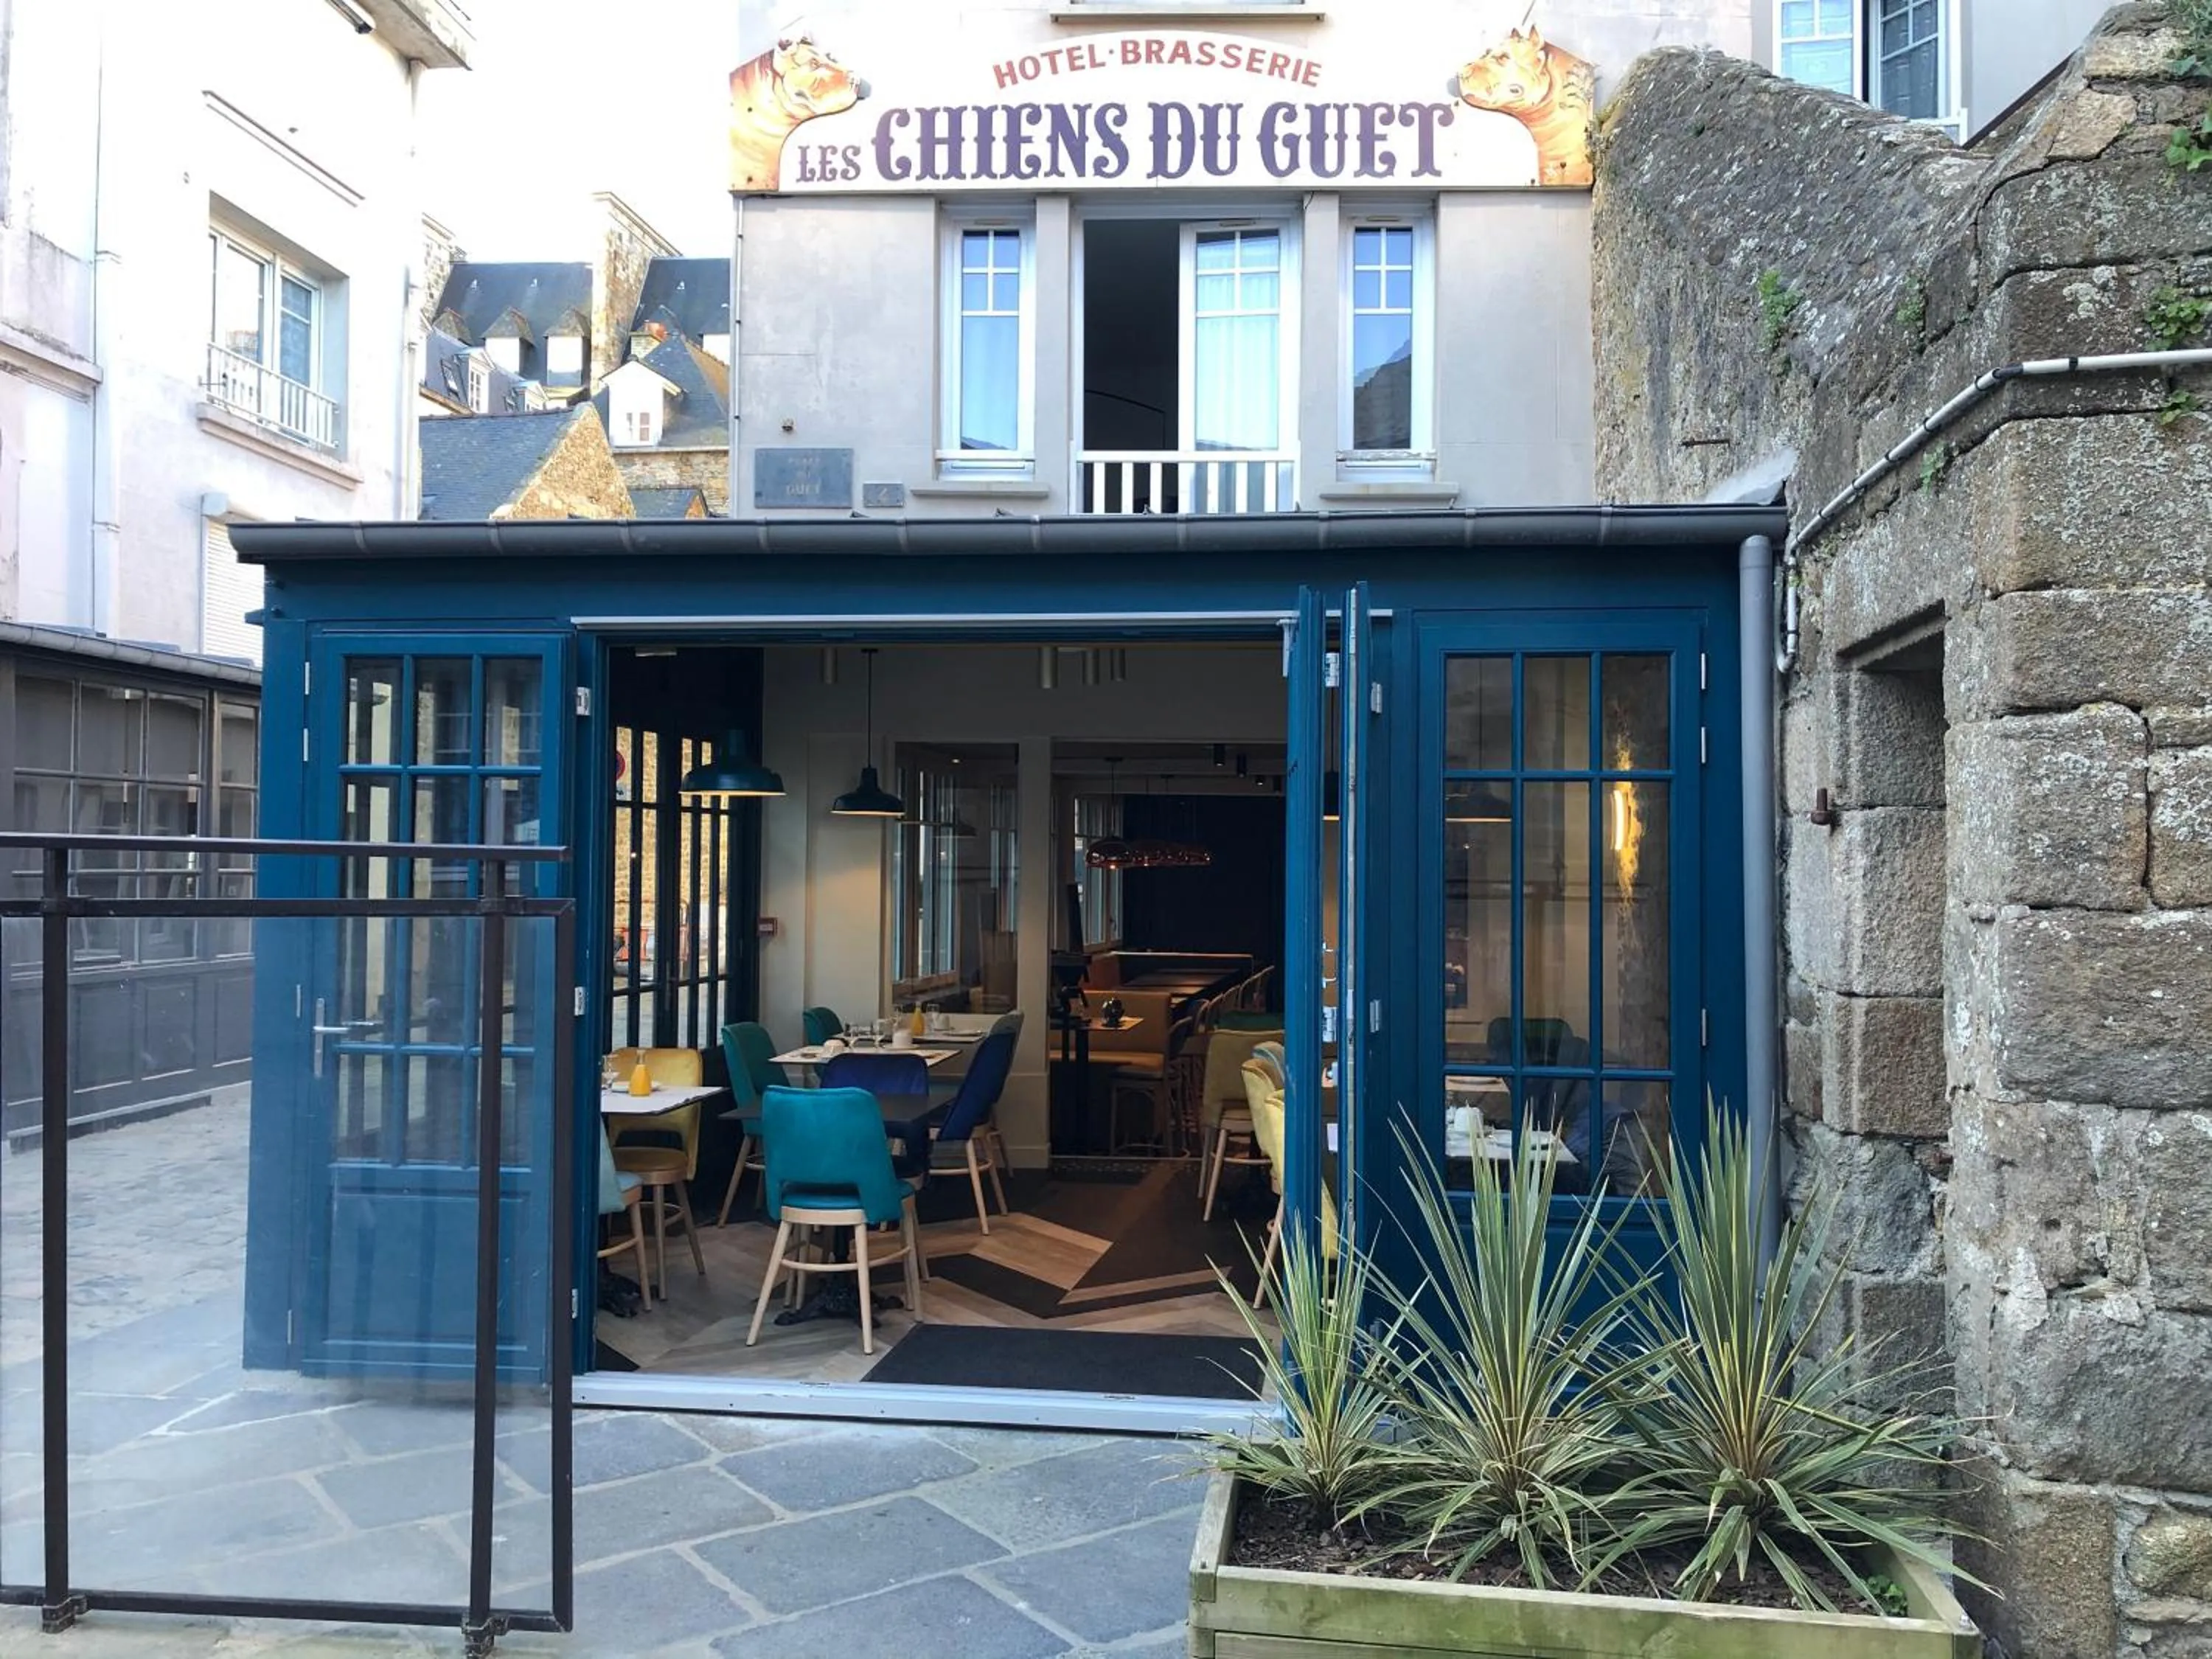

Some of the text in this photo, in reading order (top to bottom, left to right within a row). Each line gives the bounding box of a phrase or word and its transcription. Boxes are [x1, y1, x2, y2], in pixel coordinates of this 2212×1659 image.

[1120, 39, 1322, 88] BRASSERIE
[796, 101, 1455, 182] LES CHIENS DU GUET
